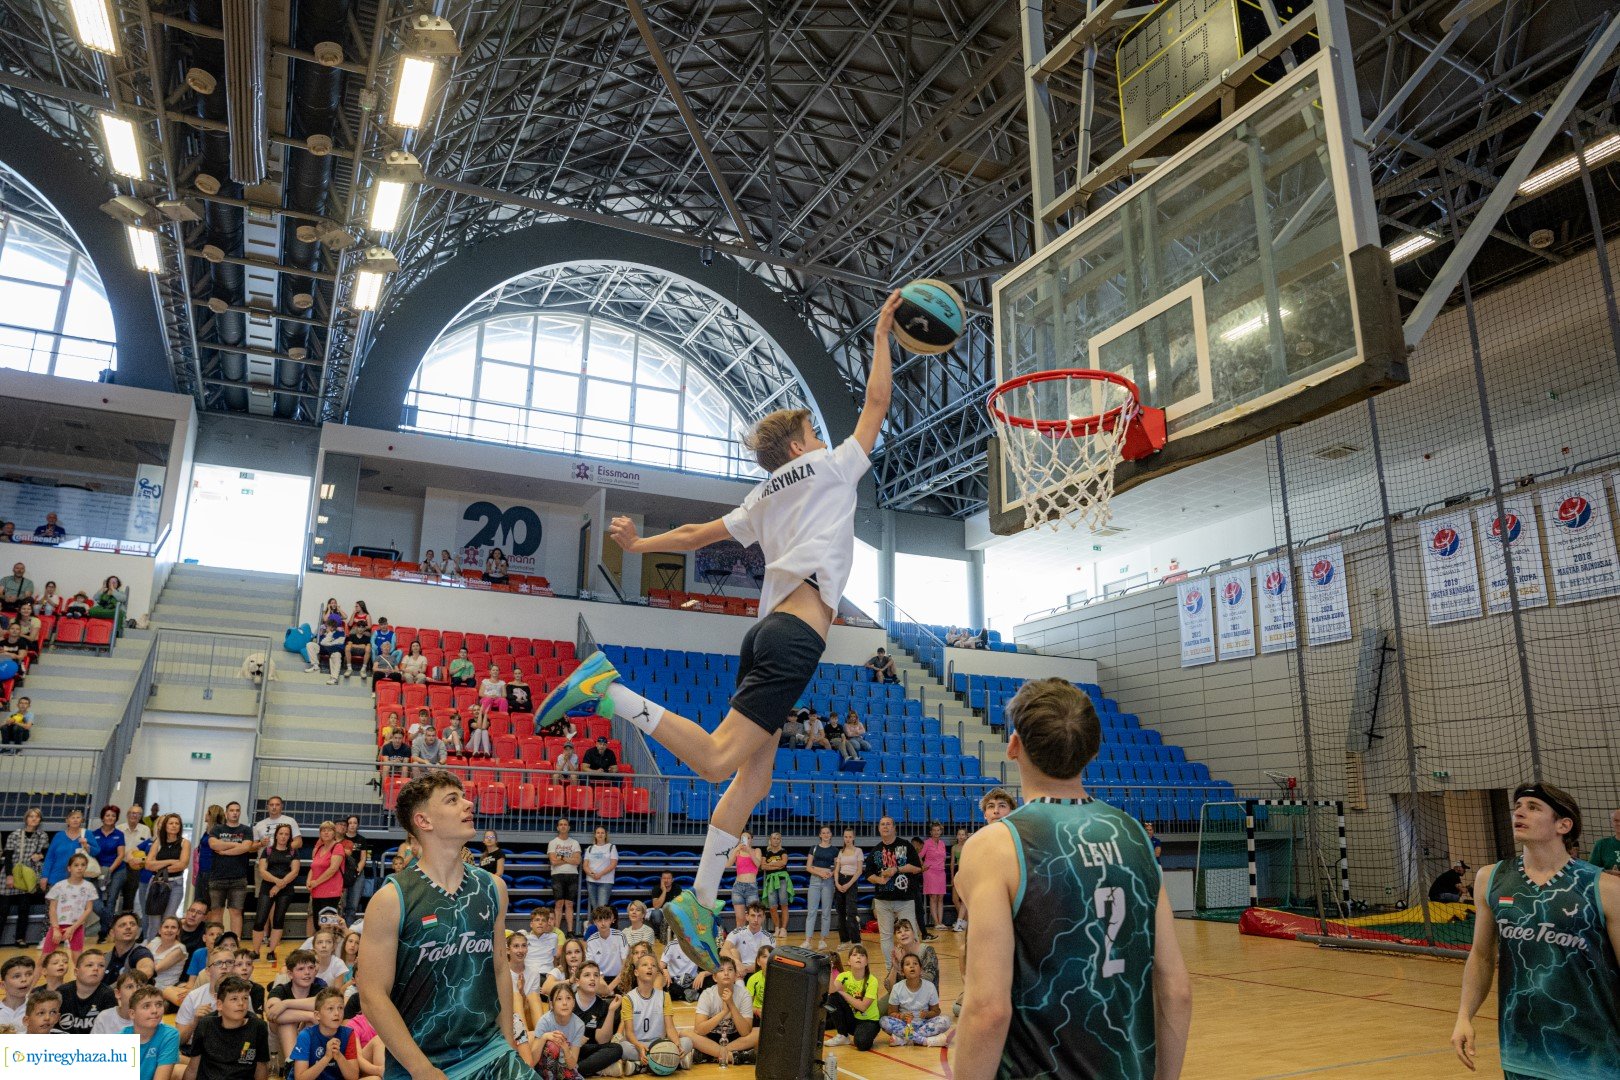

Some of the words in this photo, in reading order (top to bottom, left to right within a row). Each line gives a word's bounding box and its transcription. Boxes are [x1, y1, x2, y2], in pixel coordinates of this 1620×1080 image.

[597, 465, 640, 480] Eissmann
[463, 501, 542, 557] 20
[12, 533, 61, 544] Continental
[1573, 552, 1592, 563] 2018
[1078, 841, 1123, 868] LEVI
[1094, 886, 1127, 979] 2
[73, 1016, 95, 1029] JAK
